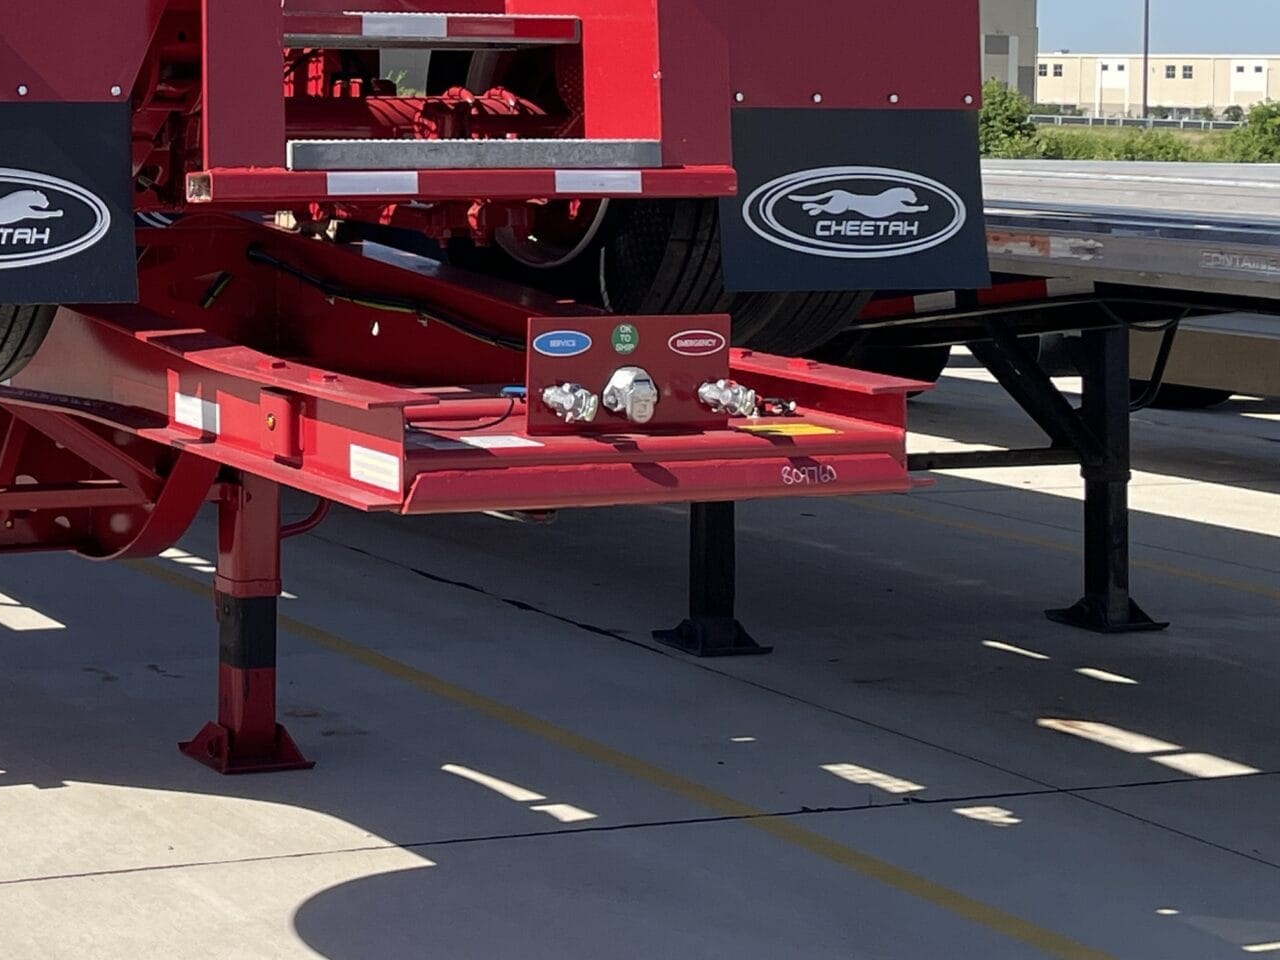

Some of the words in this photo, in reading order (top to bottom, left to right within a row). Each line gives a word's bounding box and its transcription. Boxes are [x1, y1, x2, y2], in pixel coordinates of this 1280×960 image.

[815, 220, 919, 236] CHEETAH
[619, 325, 632, 333] OK
[620, 334, 631, 342] TO
[549, 339, 577, 348] SERVICE
[615, 343, 635, 352] SHIP
[676, 339, 717, 348] EMERGENCY
[781, 465, 837, 485] 809760
